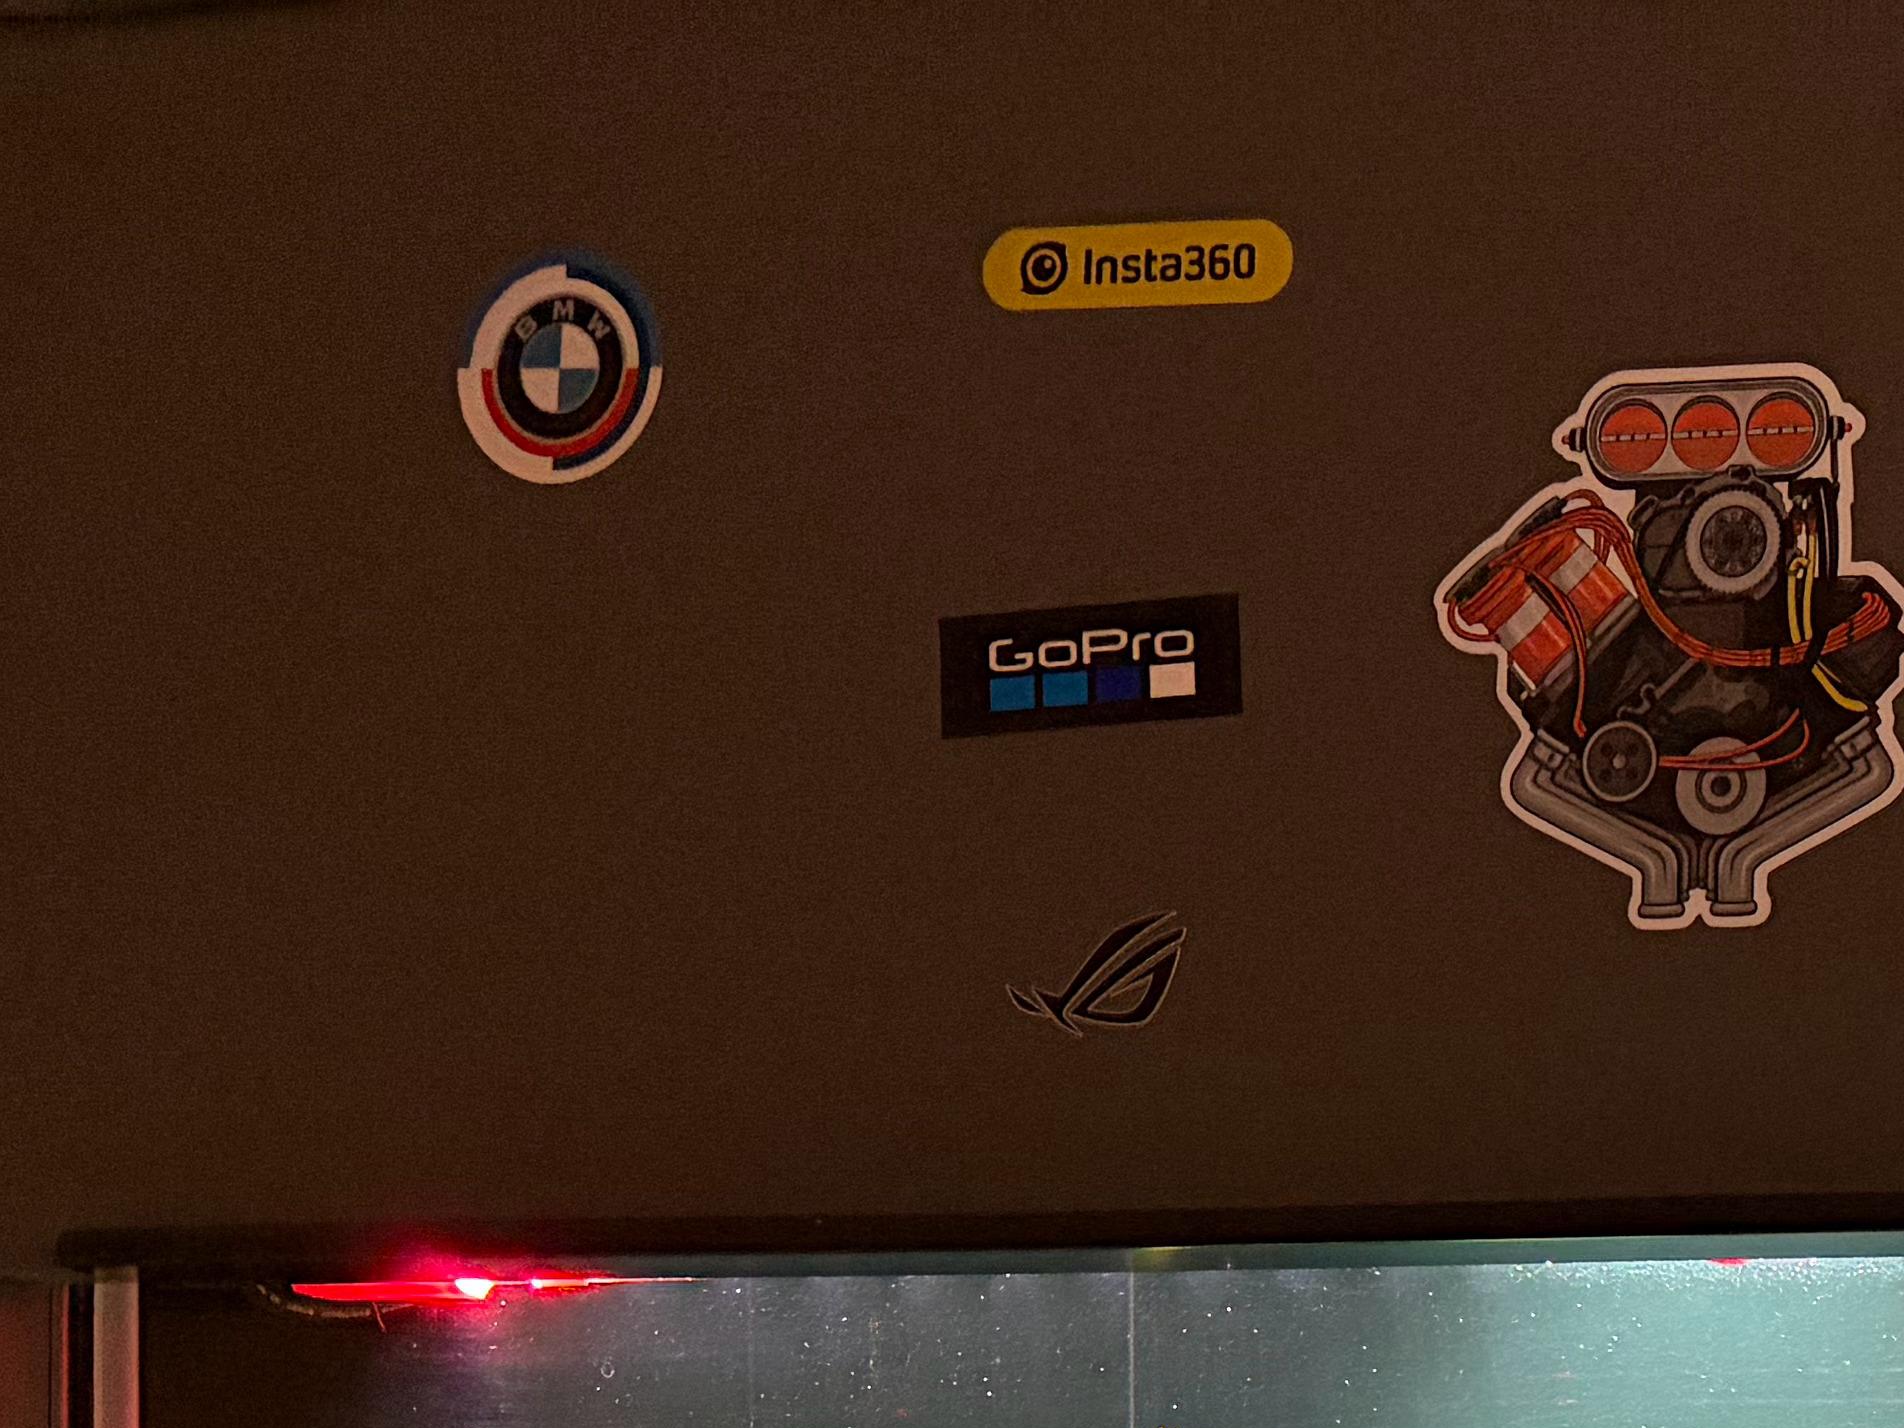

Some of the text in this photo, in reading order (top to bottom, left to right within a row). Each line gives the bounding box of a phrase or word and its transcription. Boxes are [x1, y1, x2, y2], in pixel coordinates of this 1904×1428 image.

[1083, 243, 1256, 285] Insta360
[514, 299, 611, 342] BMW
[987, 628, 1195, 673] GoPro
